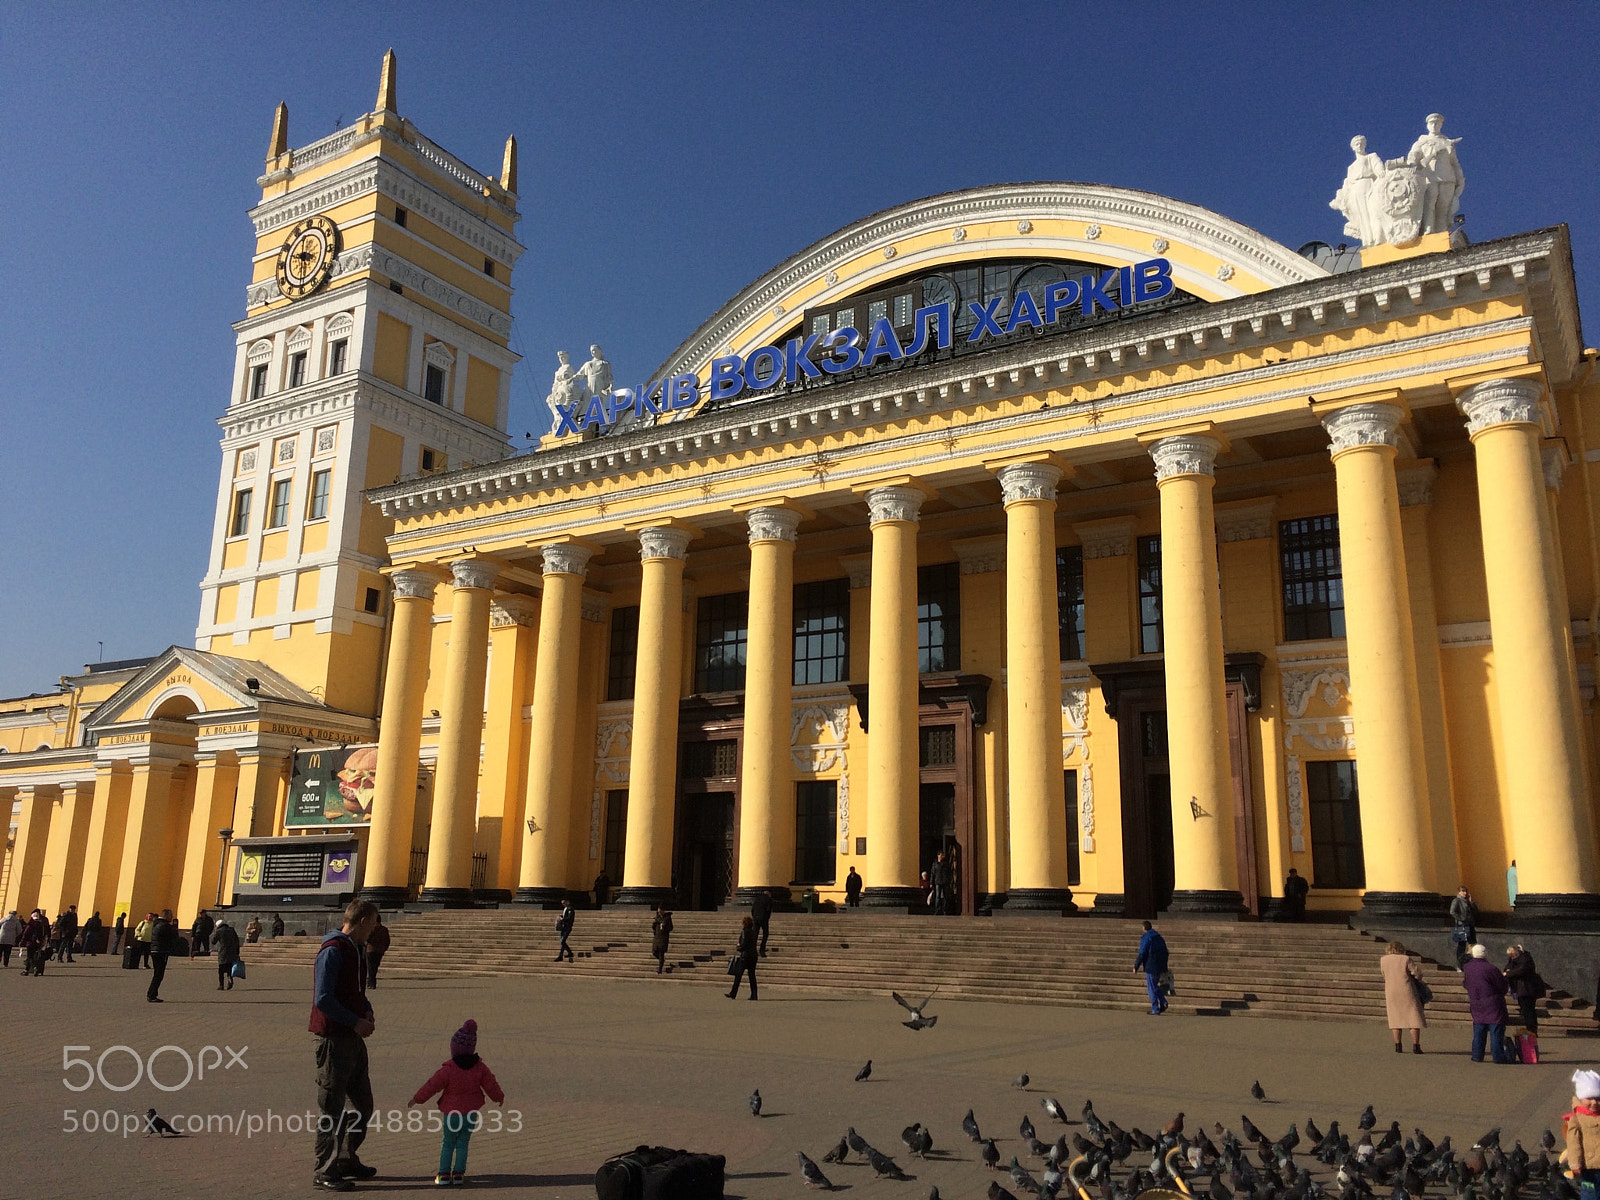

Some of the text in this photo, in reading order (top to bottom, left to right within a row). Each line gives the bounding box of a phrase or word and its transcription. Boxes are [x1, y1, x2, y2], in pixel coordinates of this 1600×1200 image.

[555, 372, 700, 438] ХАРКІВ
[709, 301, 953, 400] ВОКЗАЛ
[967, 257, 1174, 342] ХАРКІВ
[166, 675, 192, 686] ВЫХОД
[272, 723, 304, 736] ВЫХОД
[301, 793, 315, 802] 600
